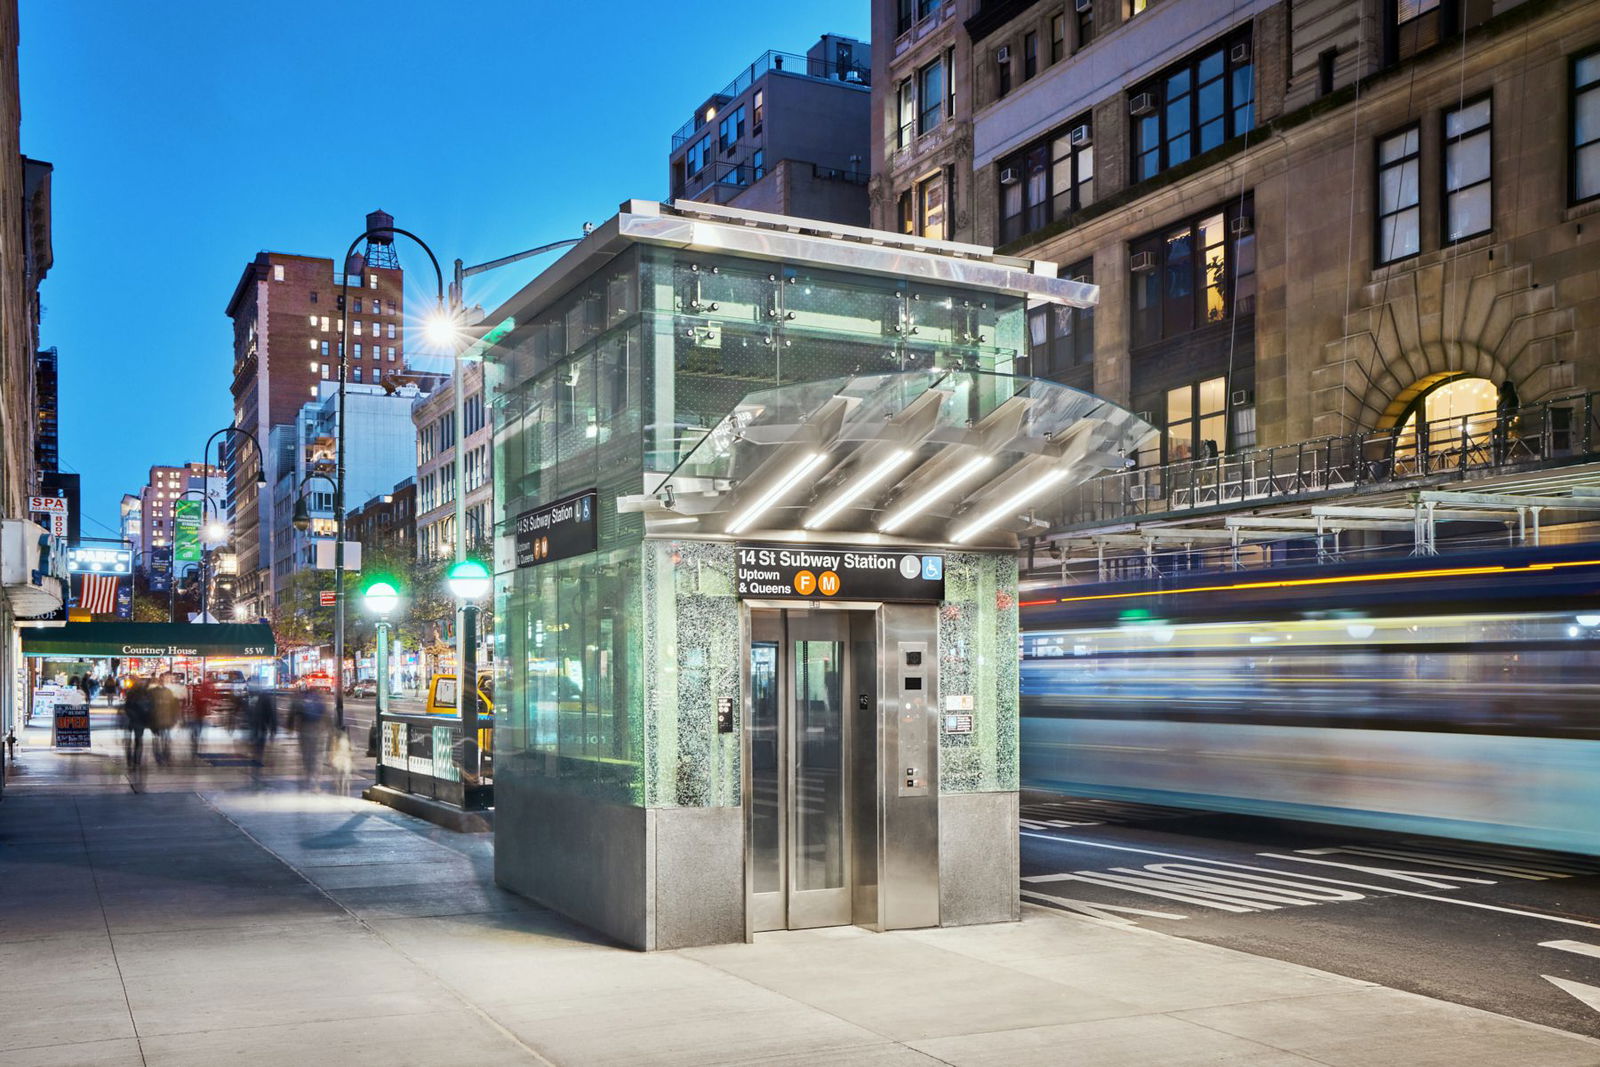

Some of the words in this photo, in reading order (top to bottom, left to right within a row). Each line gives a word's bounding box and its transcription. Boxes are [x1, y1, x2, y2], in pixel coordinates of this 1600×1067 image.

[32, 497, 64, 508] SPA
[530, 513, 551, 530] Subway
[551, 505, 573, 524] Station
[739, 551, 756, 566] 14
[759, 550, 776, 566] St
[779, 551, 840, 571] Subway
[844, 554, 896, 570] Station
[739, 568, 780, 582] Uptown
[739, 582, 747, 594] &
[750, 582, 791, 595] Queens
[122, 646, 165, 656] Courtney
[168, 646, 197, 655] House
[244, 647, 254, 655] 55
[254, 647, 265, 655] W
